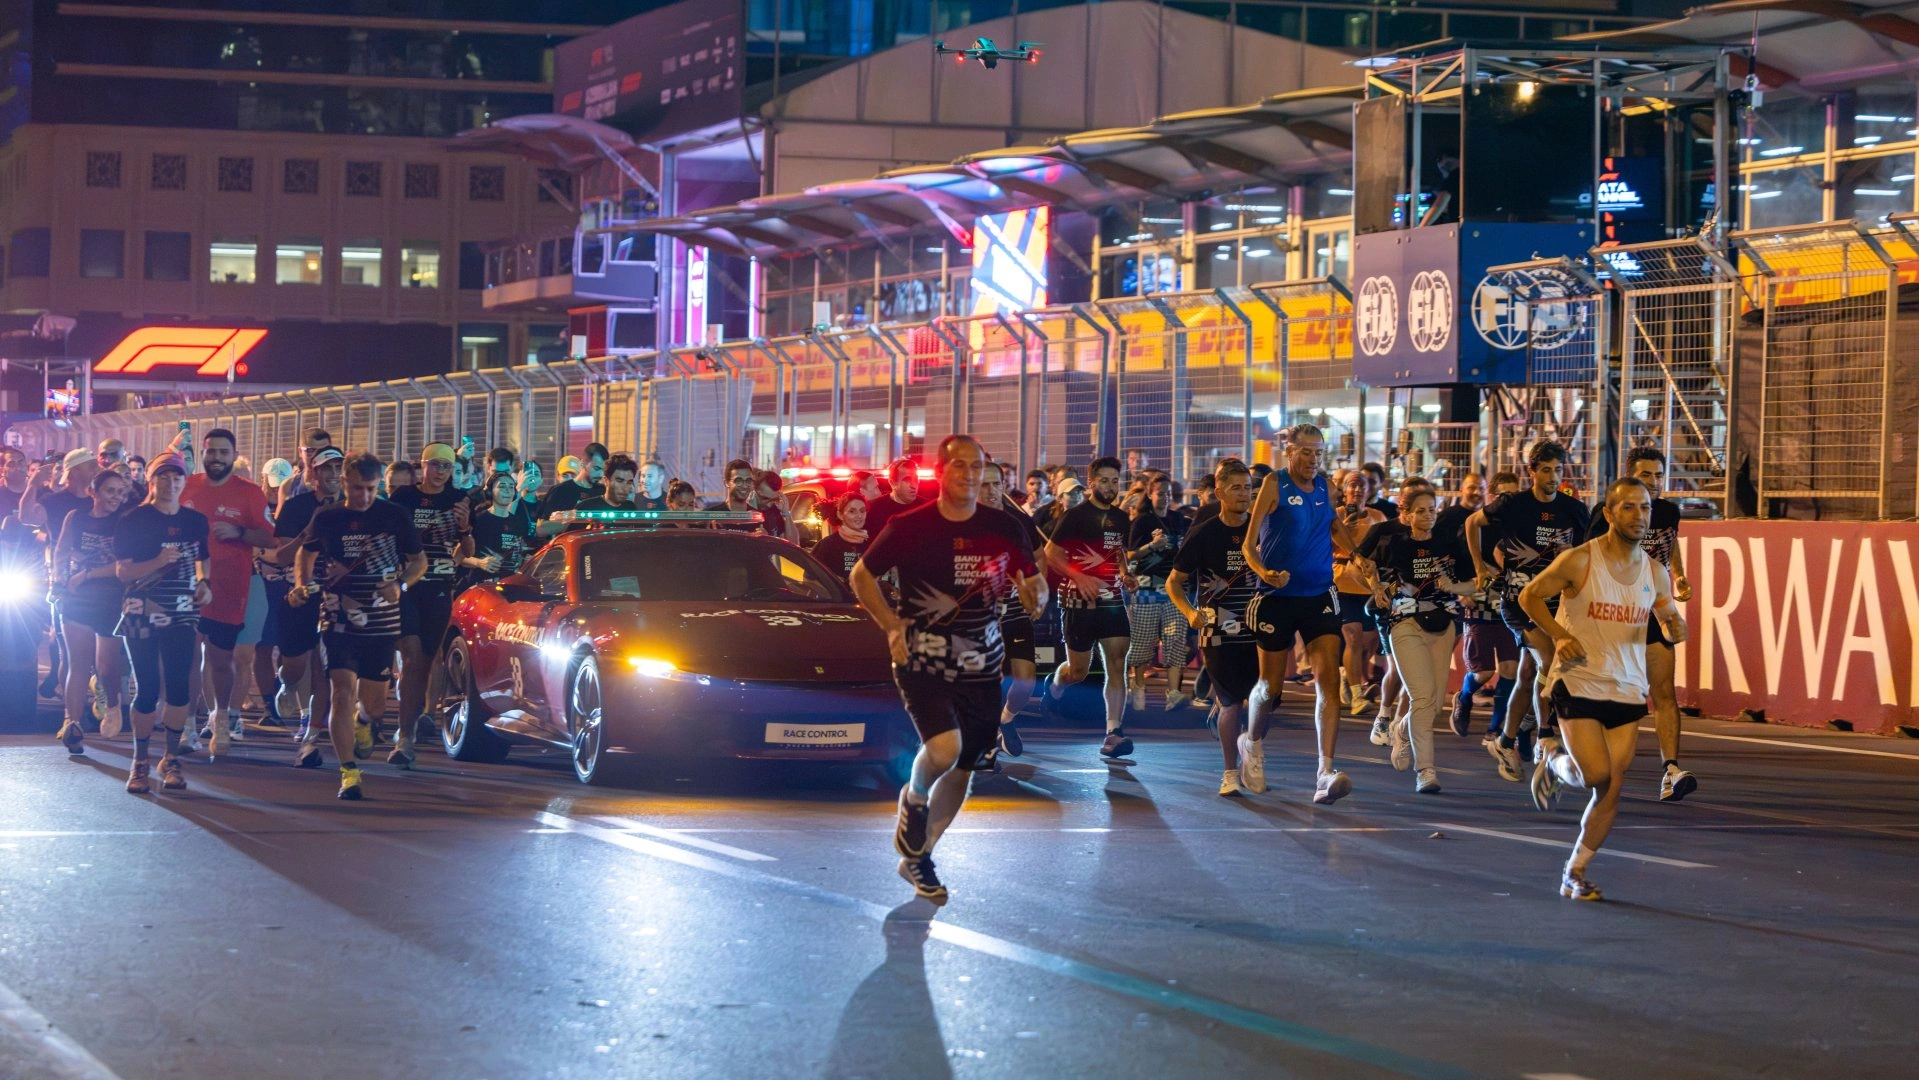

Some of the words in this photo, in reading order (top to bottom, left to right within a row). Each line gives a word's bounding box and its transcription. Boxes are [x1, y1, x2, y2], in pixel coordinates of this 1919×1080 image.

[1597, 181, 1629, 193] ATA
[953, 555, 982, 563] BAKU
[954, 570, 992, 578] CIRCUIT
[953, 578, 977, 586] RUN
[680, 609, 742, 618] RACE
[783, 729, 806, 738] RACE
[807, 730, 848, 738] CONTROL
